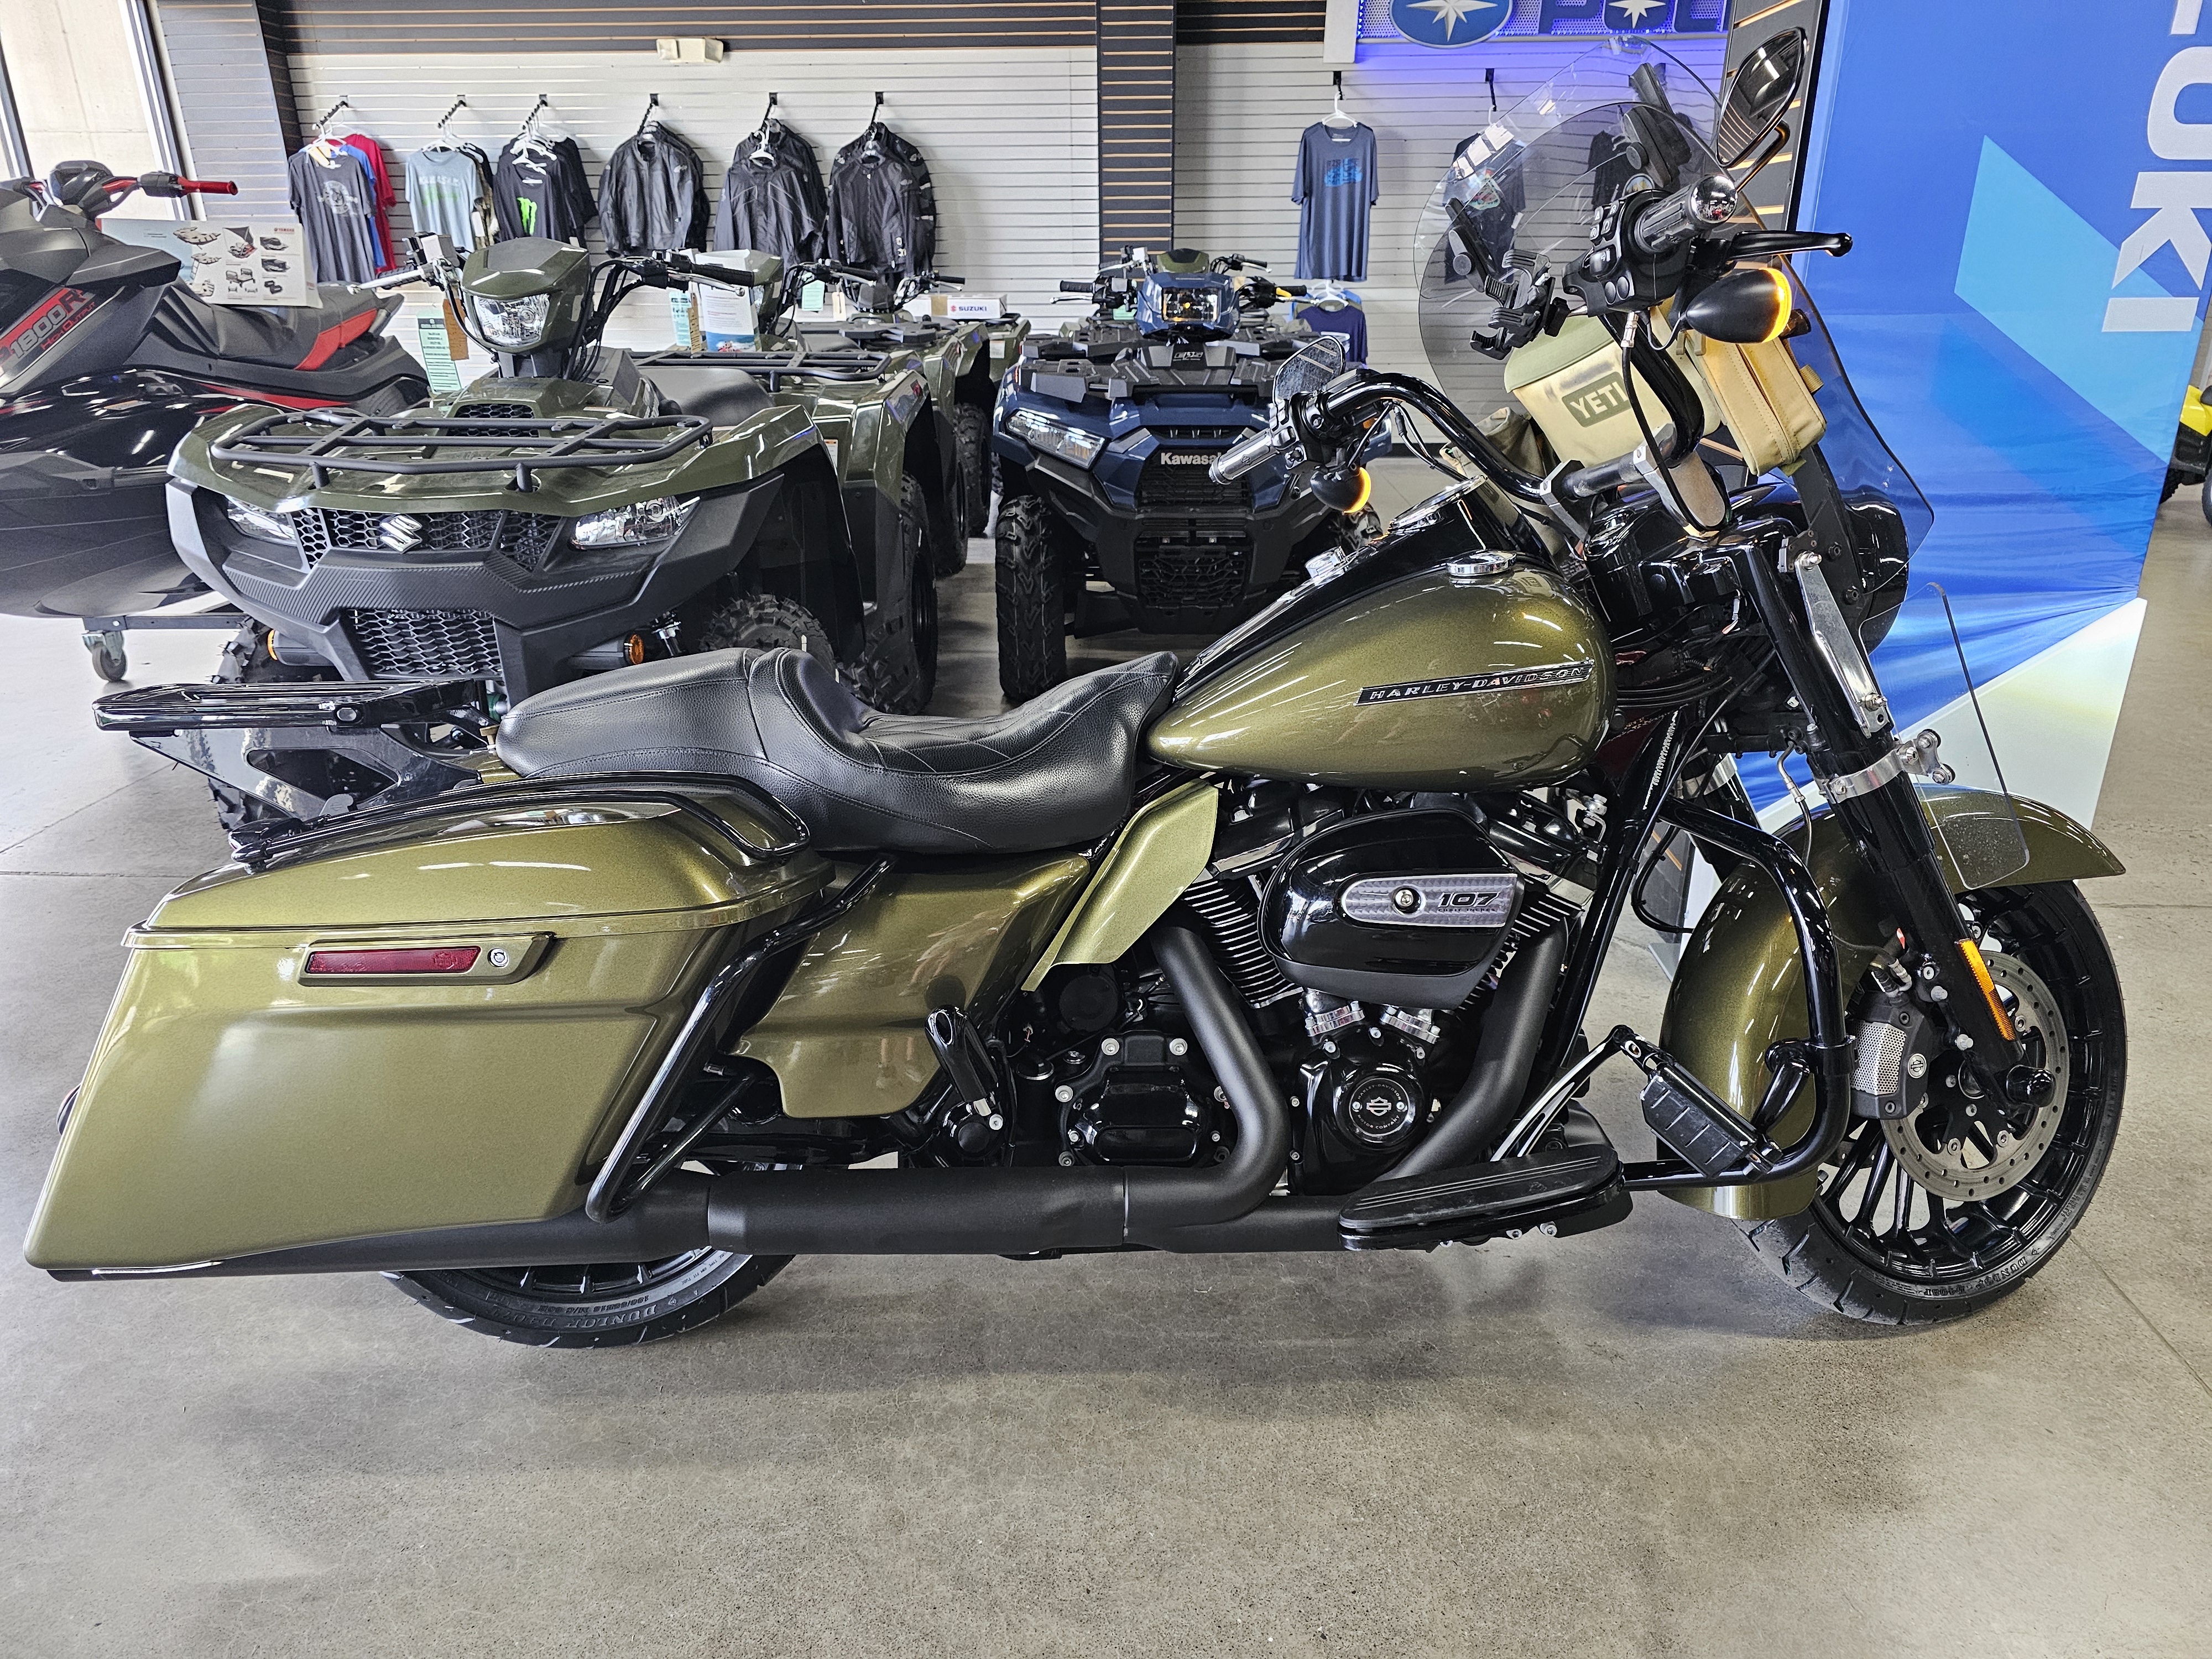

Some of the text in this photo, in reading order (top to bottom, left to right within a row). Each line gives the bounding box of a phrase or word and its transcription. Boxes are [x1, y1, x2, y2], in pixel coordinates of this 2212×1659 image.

[2102, 0, 2212, 332] UKI
[1569, 381, 1629, 419] YETI
[1161, 452, 1222, 465] Kawasa
[1369, 666, 1584, 700] HARLEY-DAVIDSON
[1437, 891, 1501, 907] 107
[1358, 1084, 1401, 1100] HARLEY-DAVIDSON
[1357, 1114, 1400, 1130] MOTOR COMPANY
[1975, 1256, 2028, 1289] DUNLOP
[565, 1304, 658, 1328] DUNLOP
